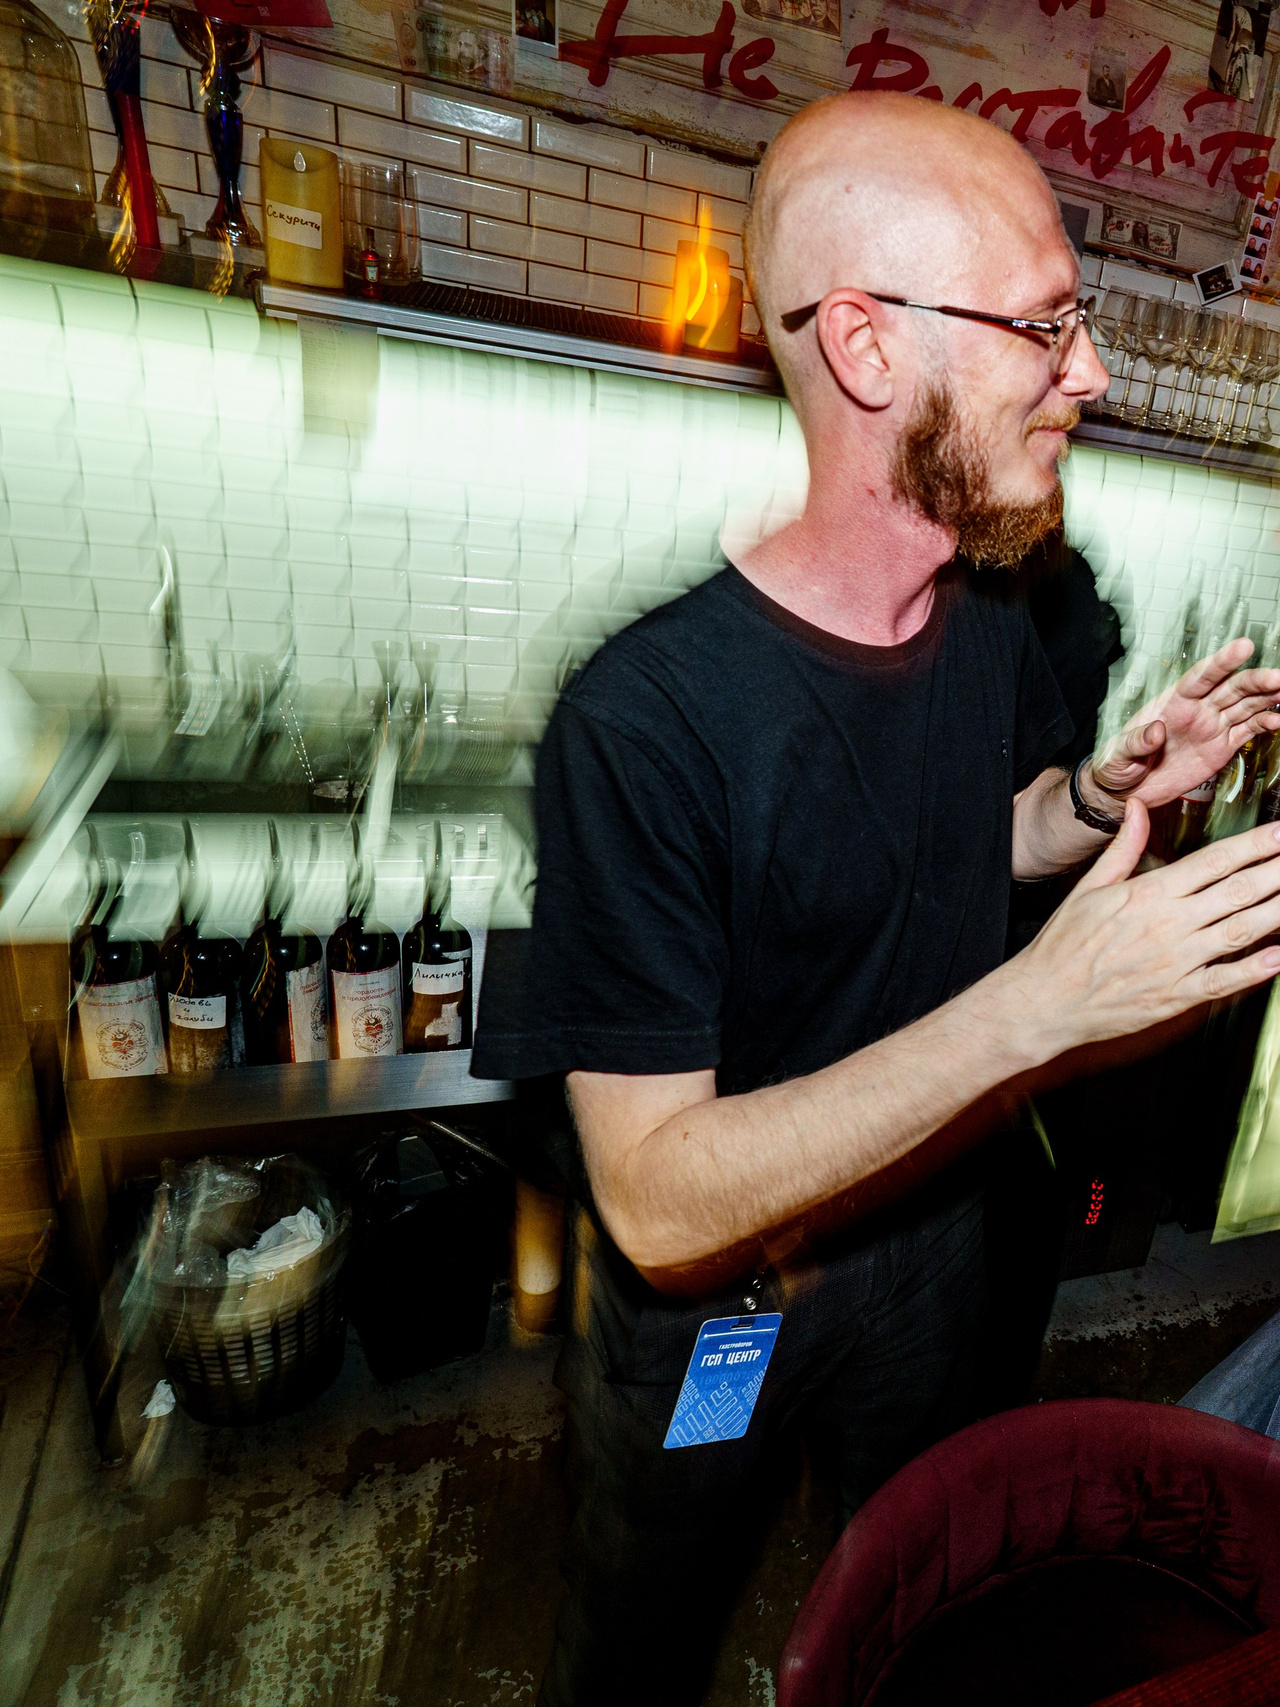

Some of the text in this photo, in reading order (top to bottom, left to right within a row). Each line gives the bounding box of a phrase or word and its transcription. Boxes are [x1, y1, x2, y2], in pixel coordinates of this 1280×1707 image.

[559, 0, 779, 100] Не
[266, 203, 321, 232] Секурити
[701, 1349, 762, 1367] ГСП ЦЕНТР
